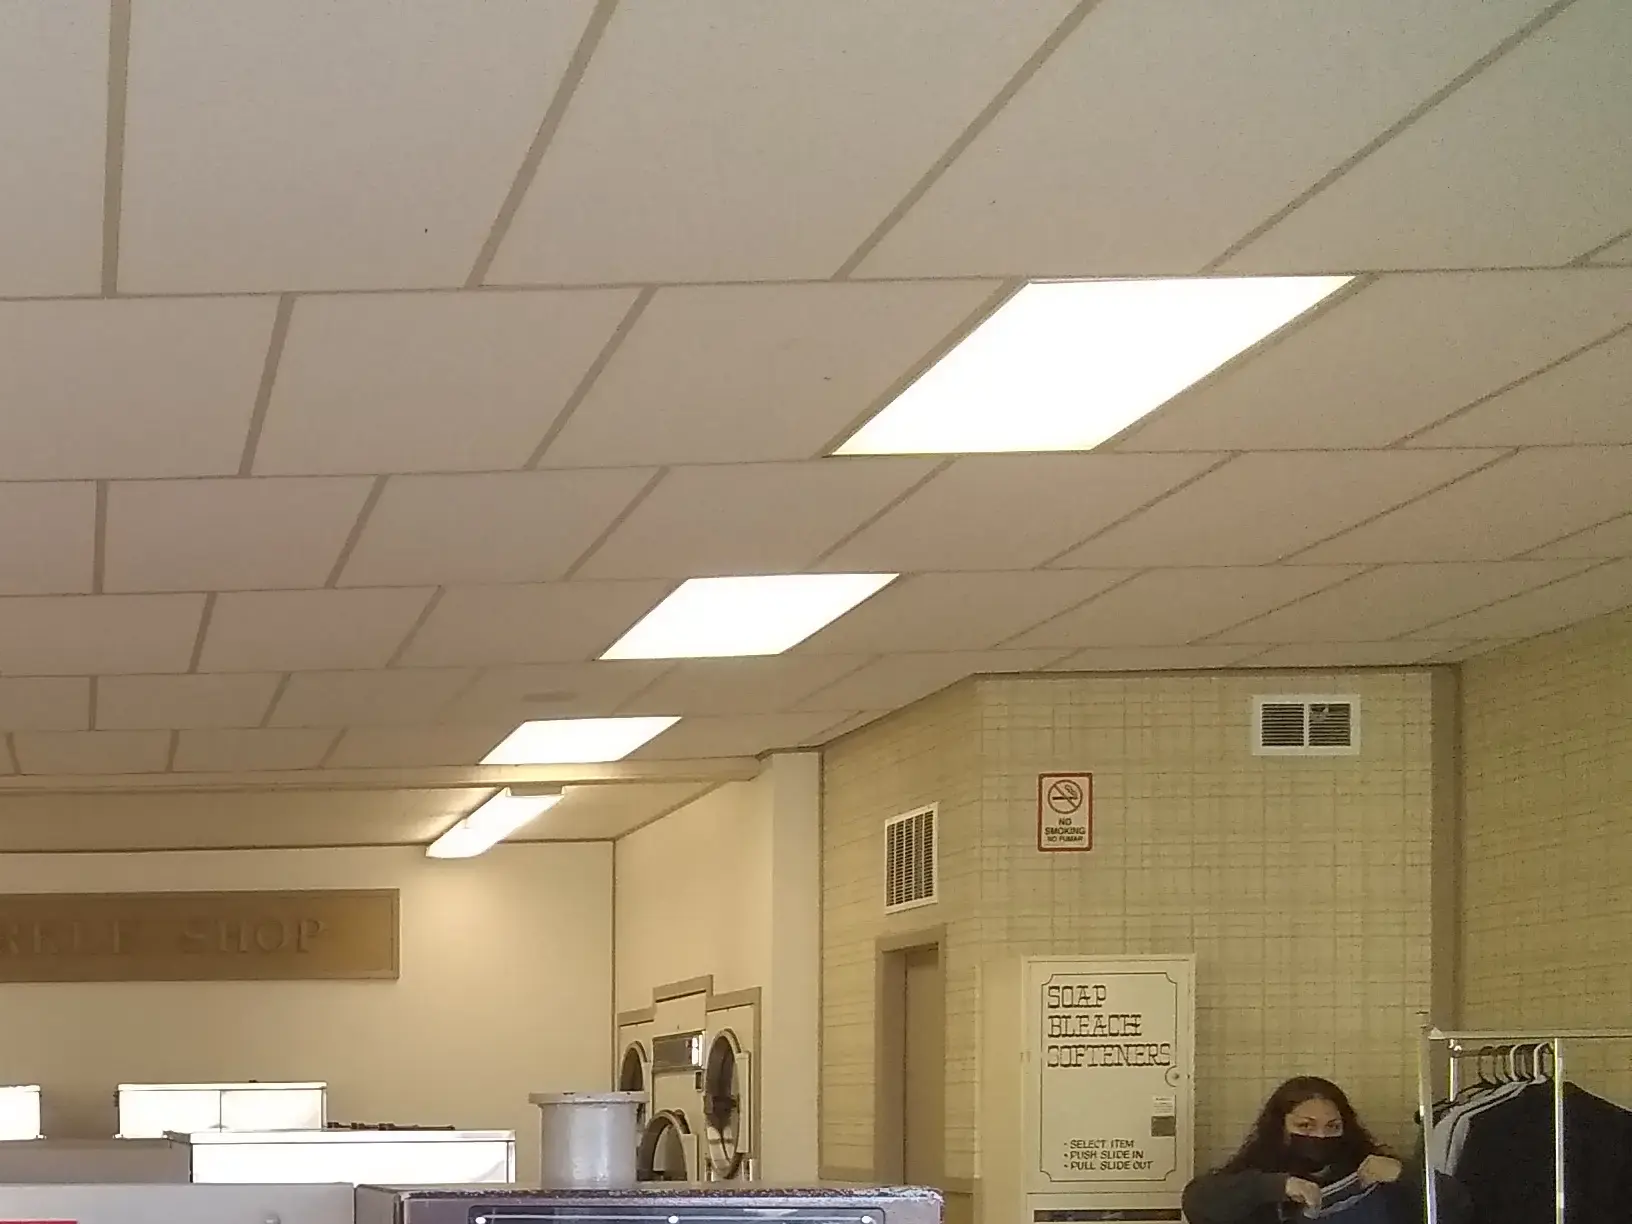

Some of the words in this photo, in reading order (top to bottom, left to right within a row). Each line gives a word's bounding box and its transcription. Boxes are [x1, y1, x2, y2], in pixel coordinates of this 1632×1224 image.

[1059, 817, 1072, 826] NO
[1044, 826, 1086, 835] SMOKING
[180, 917, 327, 955] SHOP
[1047, 985, 1106, 1008] SOAP
[1048, 1014, 1142, 1038] BLEACH
[1047, 1043, 1171, 1067] SOFTENERS
[1070, 1139, 1106, 1149] SELECT
[1111, 1139, 1135, 1148] ITEM
[1070, 1150, 1097, 1160] PUSH
[1100, 1150, 1130, 1160] SLIDE
[1132, 1150, 1144, 1159] IN
[1070, 1161, 1096, 1170] PULL
[1100, 1160, 1131, 1170] SLIDE
[1133, 1160, 1154, 1170] OUT
